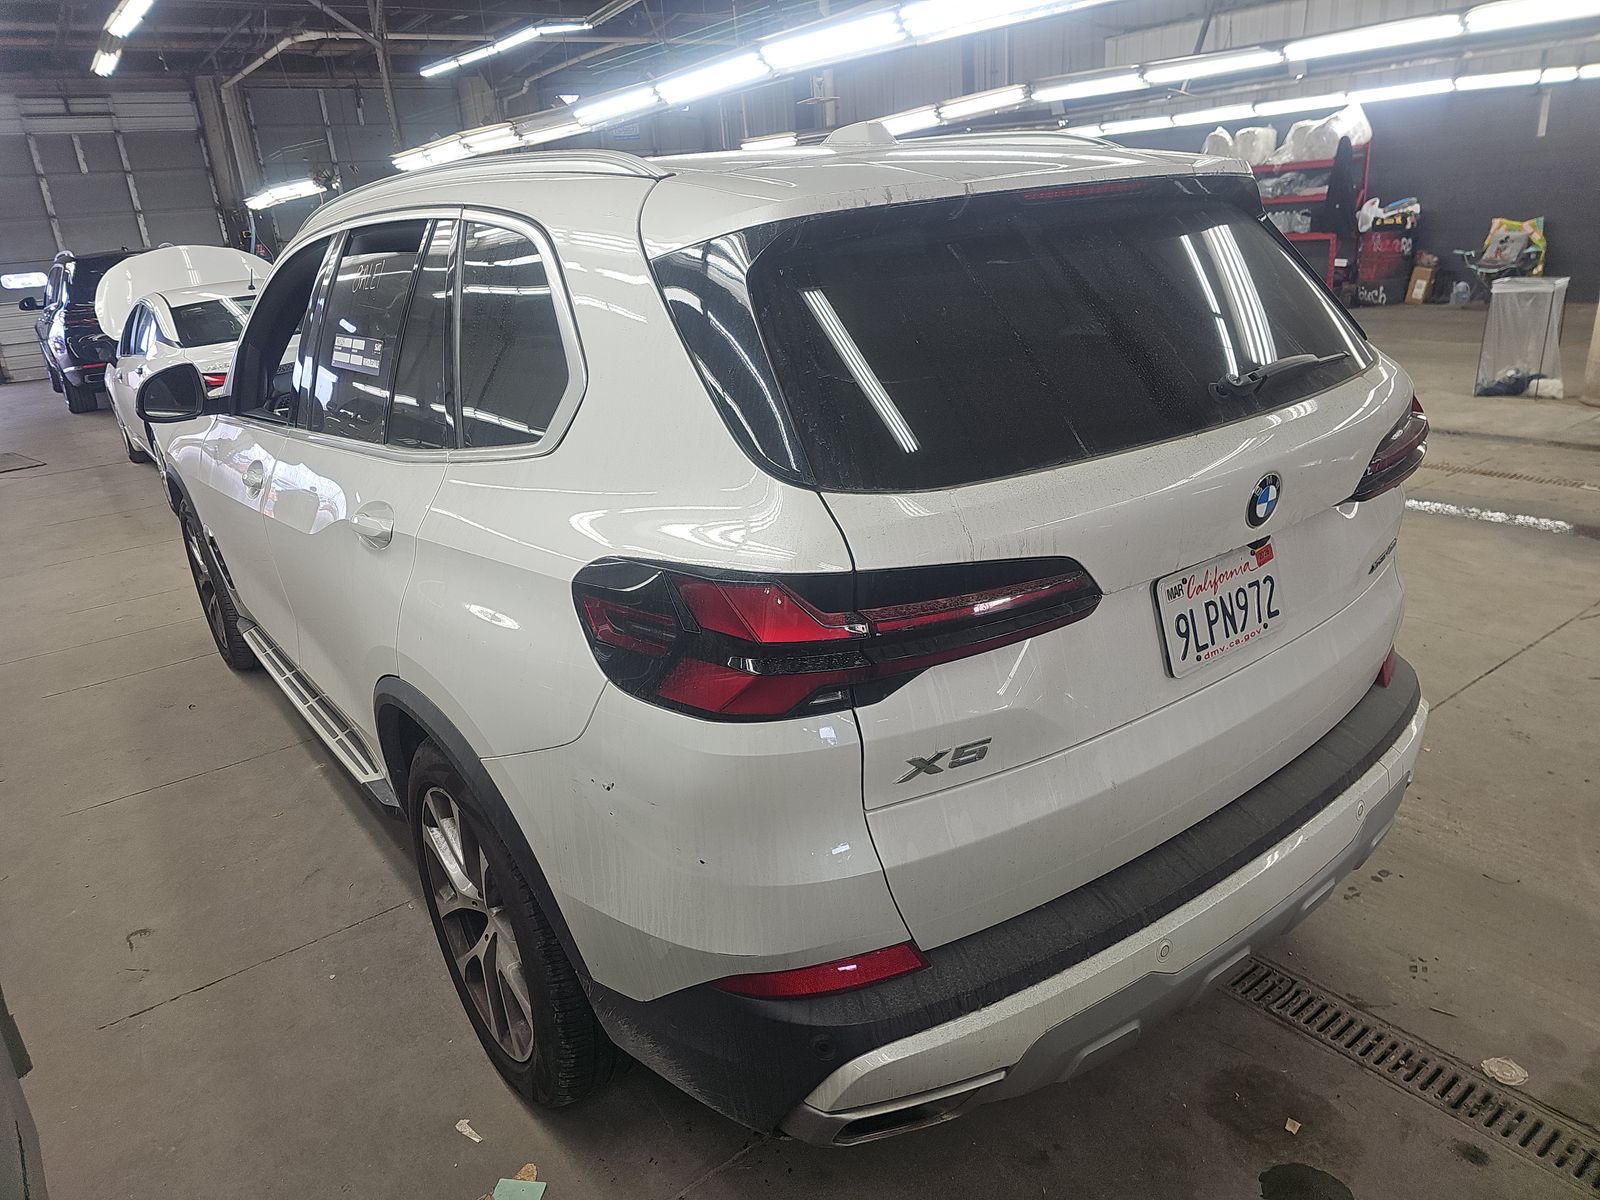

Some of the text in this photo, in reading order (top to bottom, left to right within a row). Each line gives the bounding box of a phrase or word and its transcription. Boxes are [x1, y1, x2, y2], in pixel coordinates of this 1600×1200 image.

[1167, 583, 1185, 602] MAR
[1187, 557, 1258, 600] California
[1174, 574, 1280, 662] 9LPN972
[1203, 627, 1262, 660] dmv.ca.gov
[892, 736, 993, 785] X5
